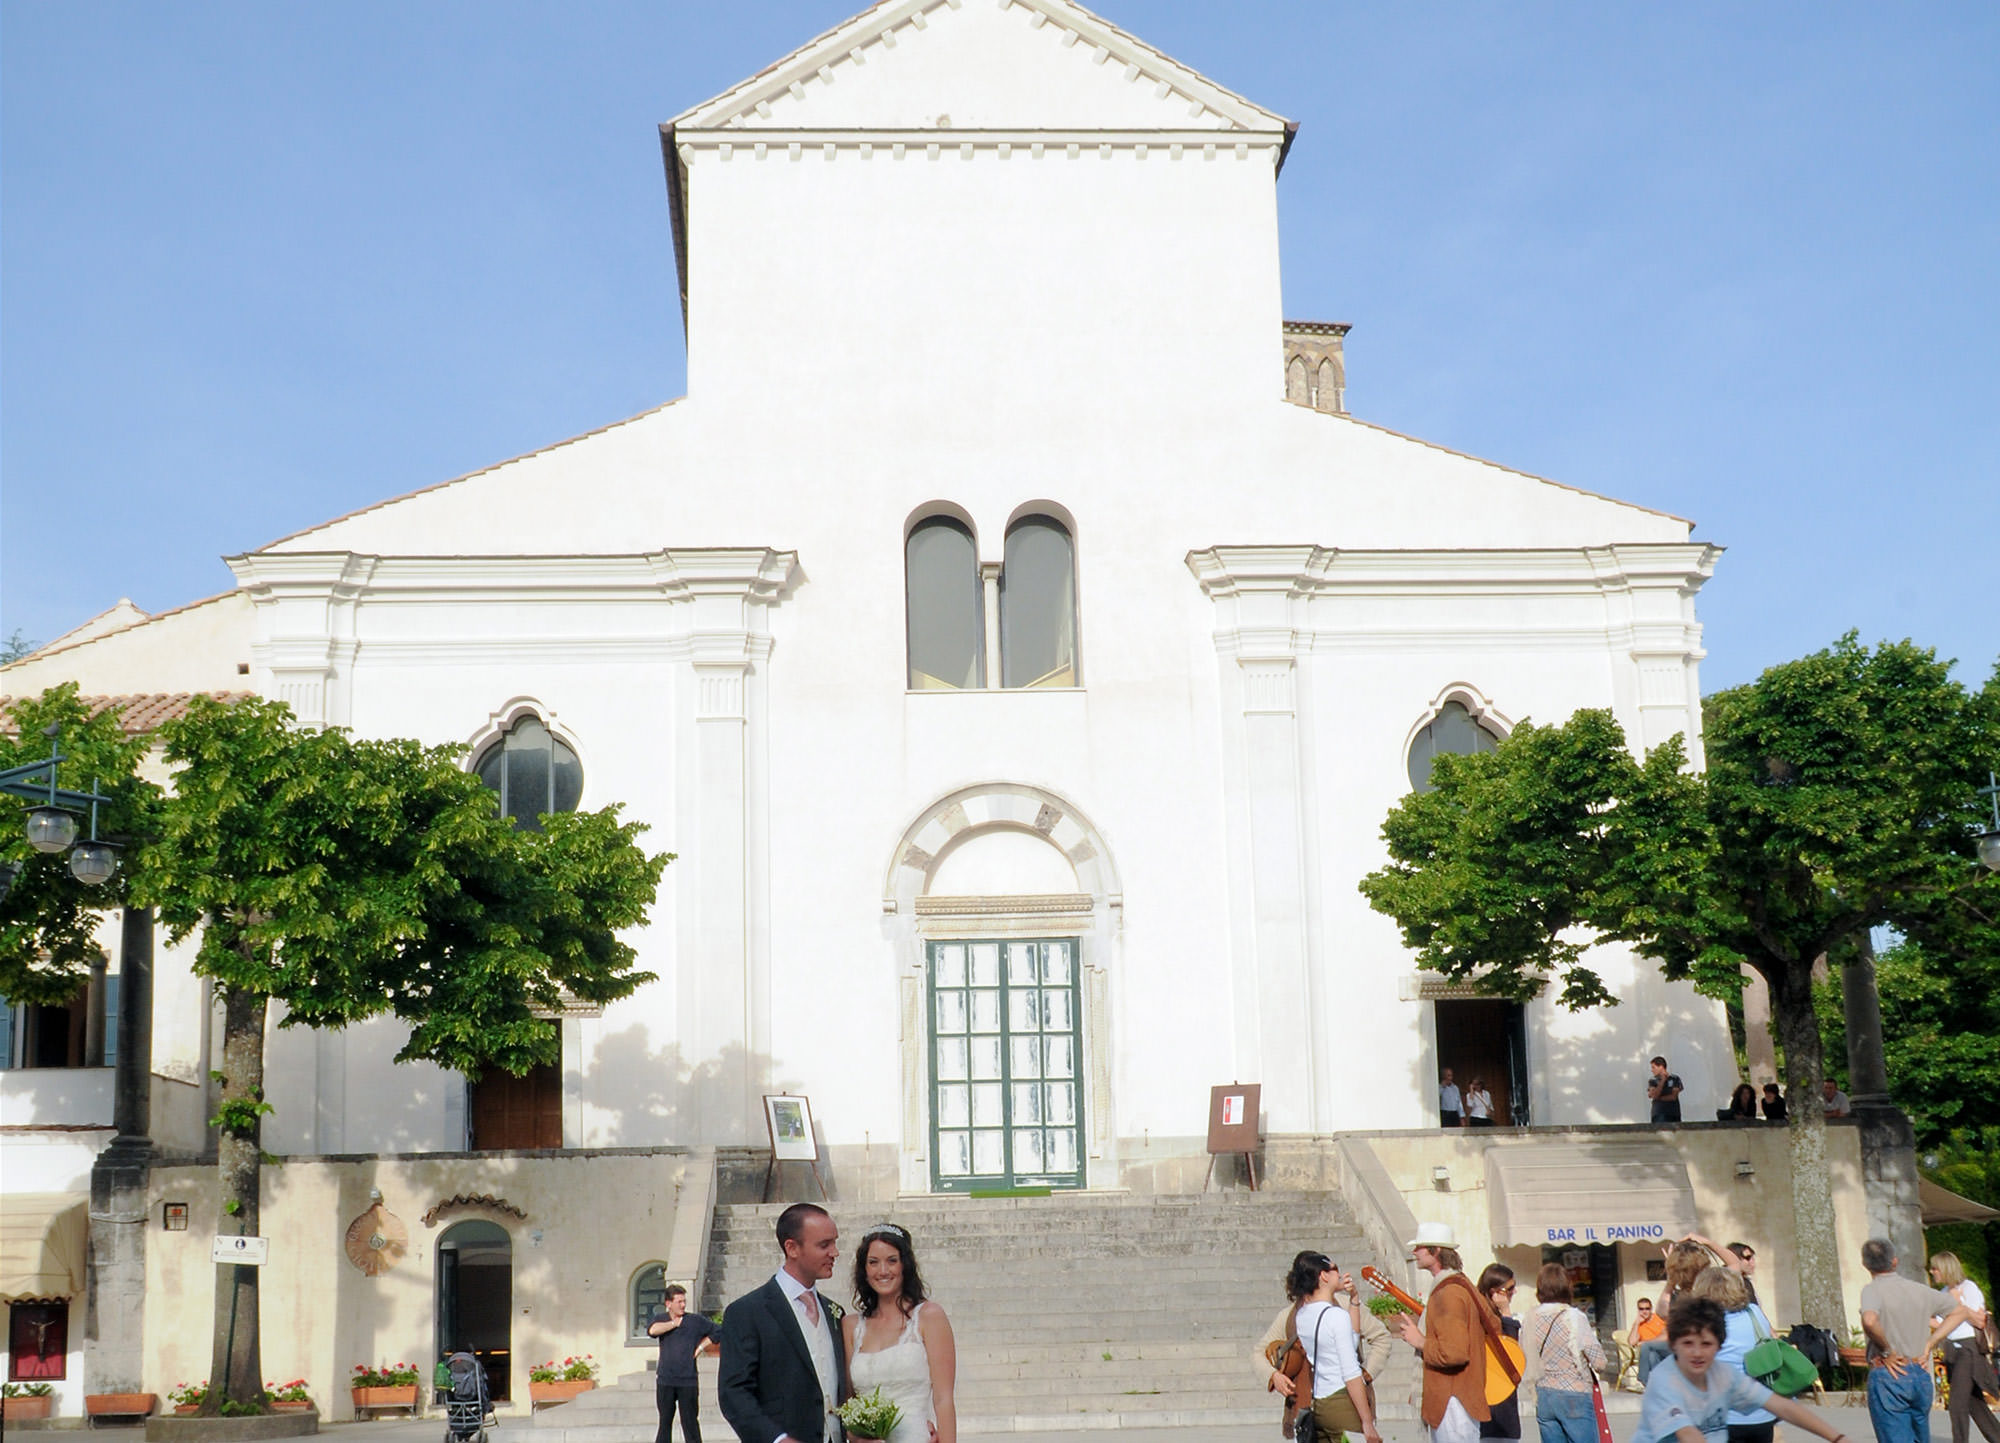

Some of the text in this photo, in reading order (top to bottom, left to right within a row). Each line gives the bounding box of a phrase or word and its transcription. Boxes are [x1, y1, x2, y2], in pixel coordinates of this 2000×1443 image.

[1547, 1224, 1664, 1241] BAR IL PANINO
